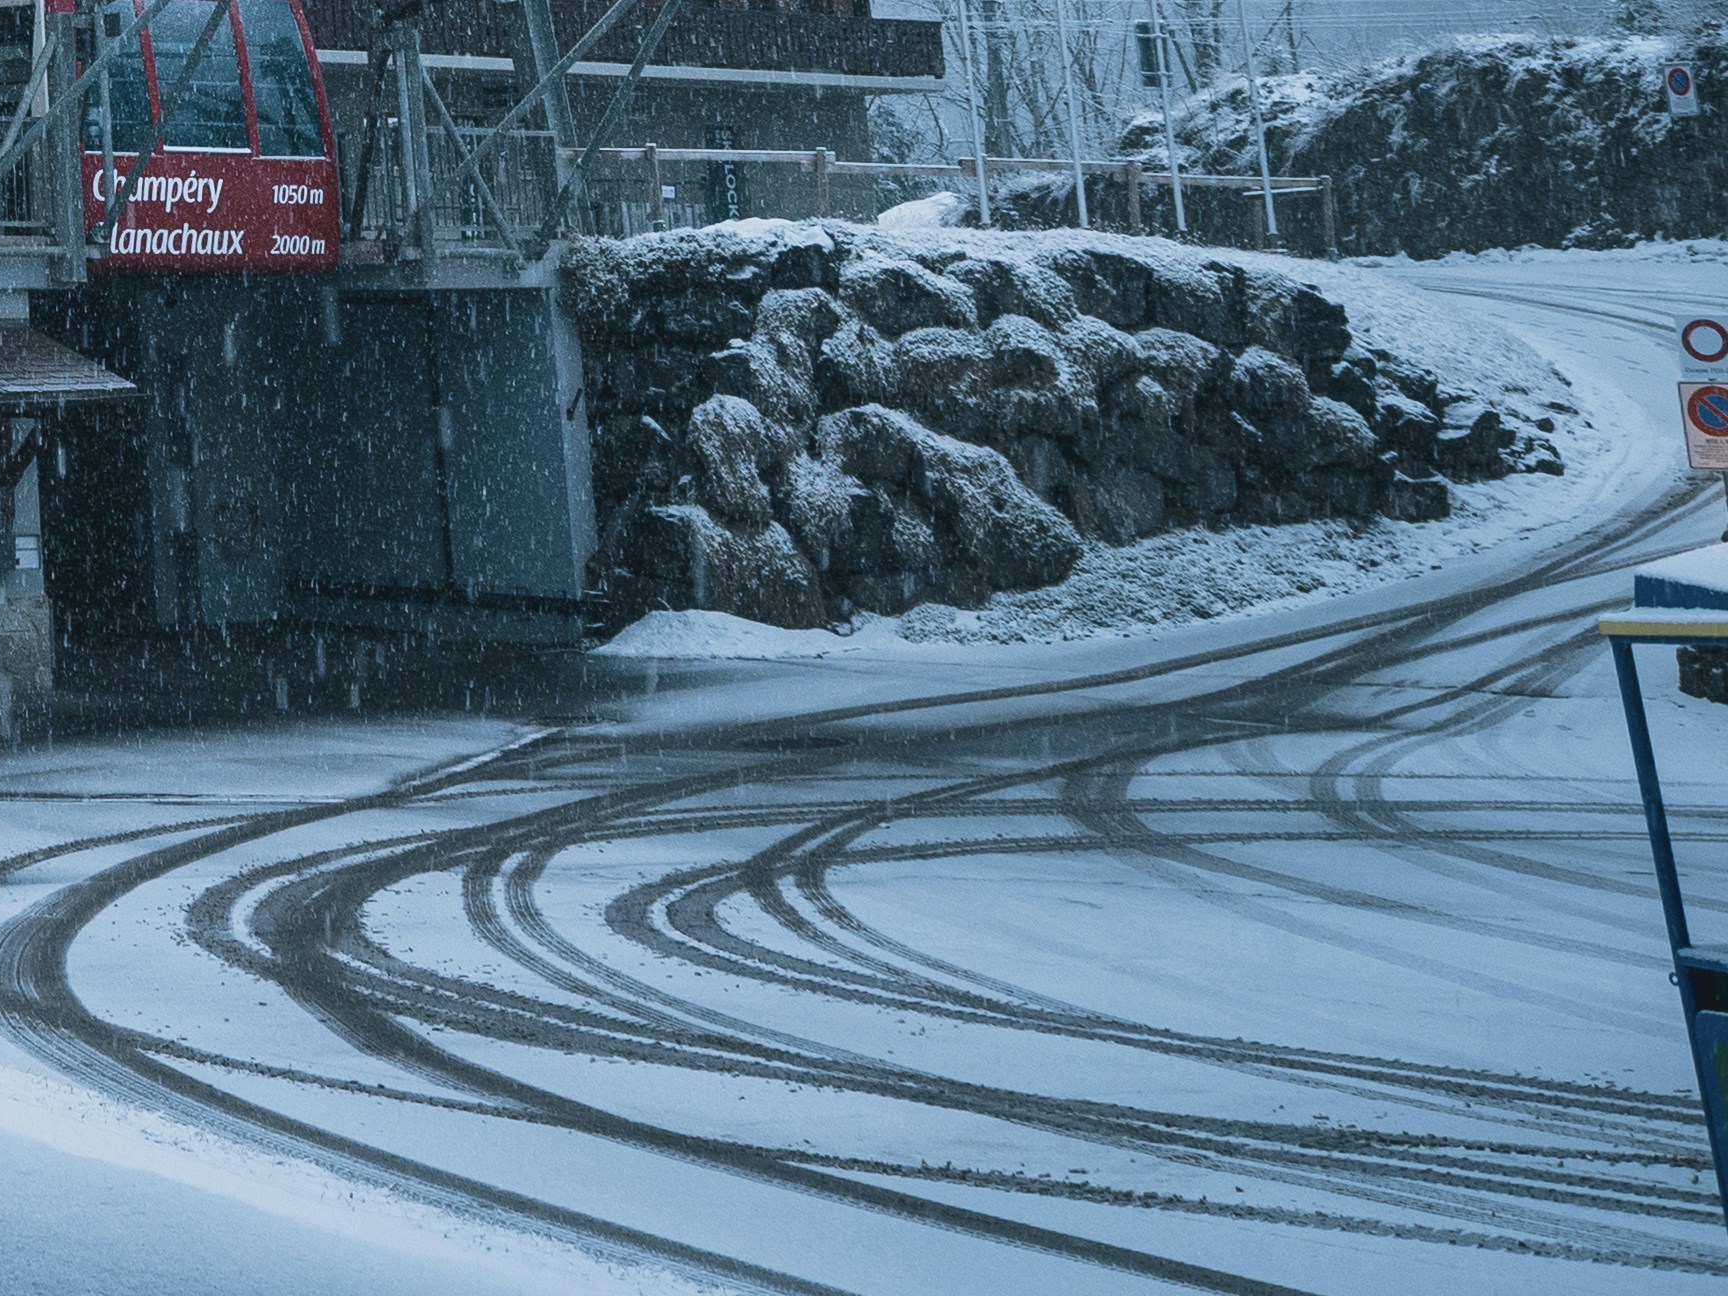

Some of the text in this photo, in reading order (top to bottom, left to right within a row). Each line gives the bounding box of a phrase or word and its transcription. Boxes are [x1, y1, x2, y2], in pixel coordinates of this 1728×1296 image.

[272, 184, 308, 205] 1050
[309, 188, 324, 205] m
[724, 164, 739, 221] LOCK
[100, 222, 326, 256] lanachaux 2000 m
